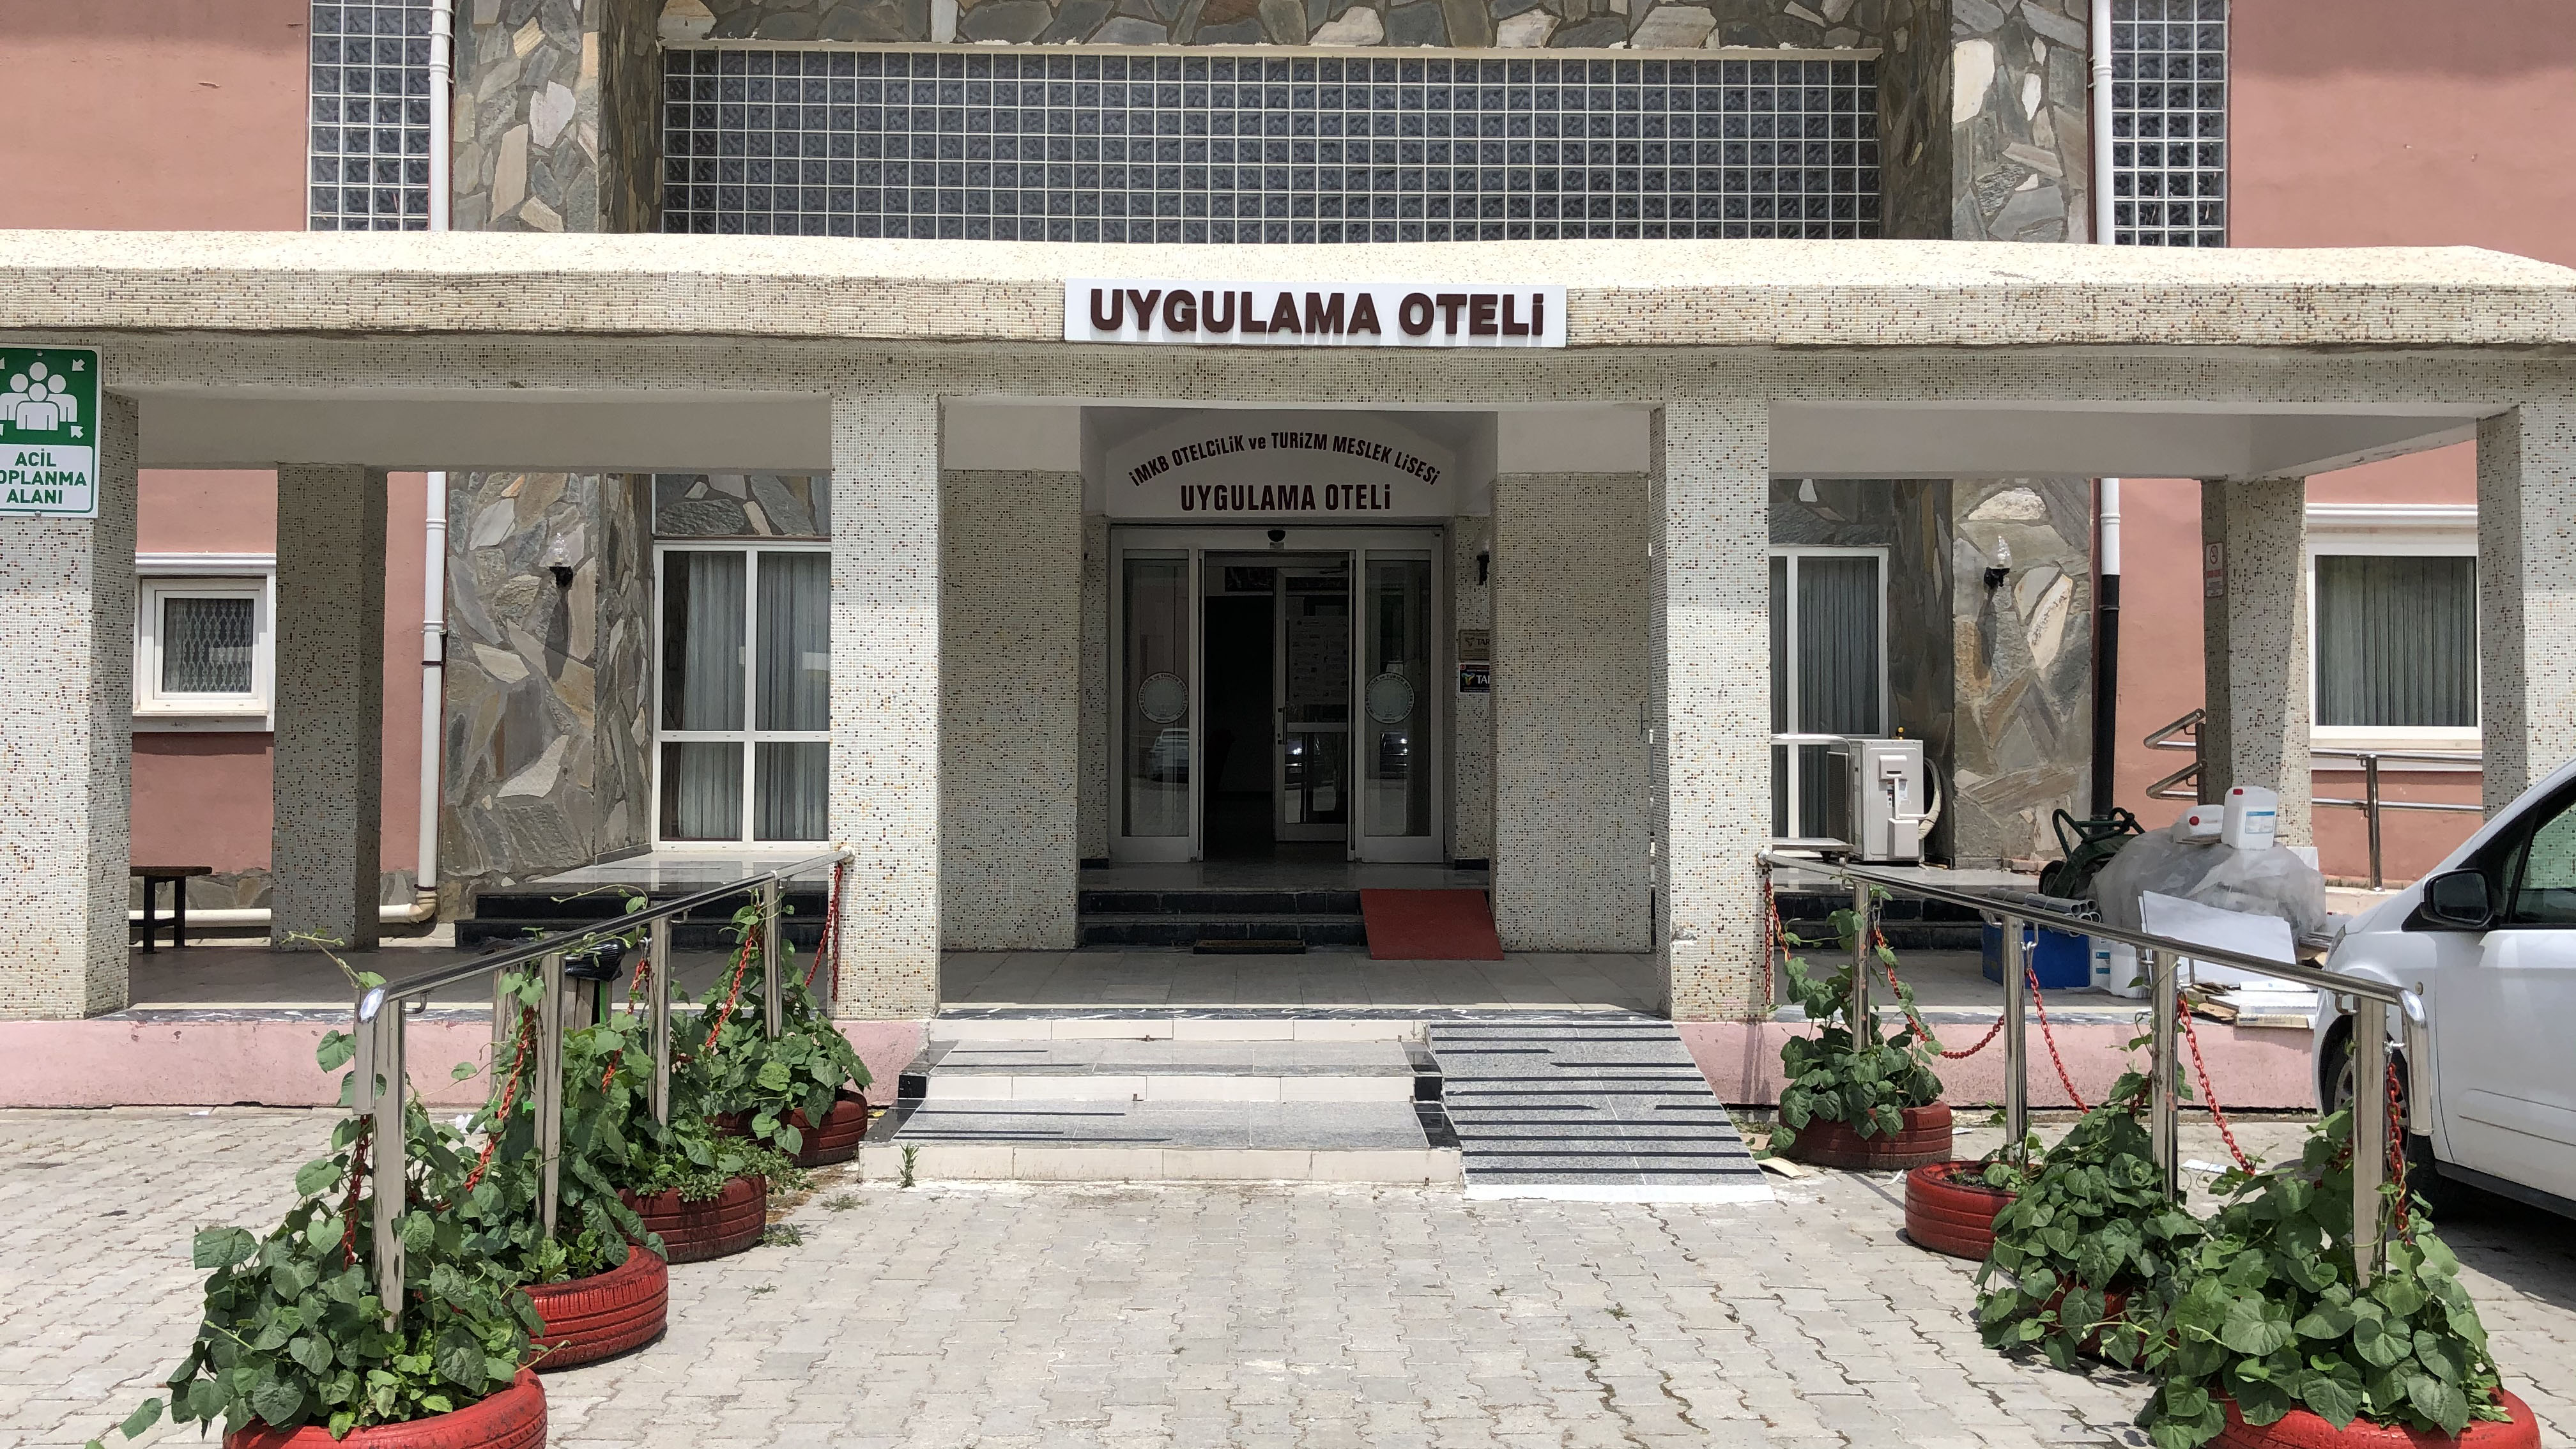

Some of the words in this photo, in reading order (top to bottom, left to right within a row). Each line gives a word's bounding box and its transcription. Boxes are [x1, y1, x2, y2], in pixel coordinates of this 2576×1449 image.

[1091, 288, 1381, 334] UYGULAMA
[15, 448, 57, 466] ACİL
[1248, 436, 1266, 450] ve
[1333, 435, 1393, 464] MESLEK
[6, 489, 63, 504] ALANI
[1181, 484, 1316, 511] UYGULAMA
